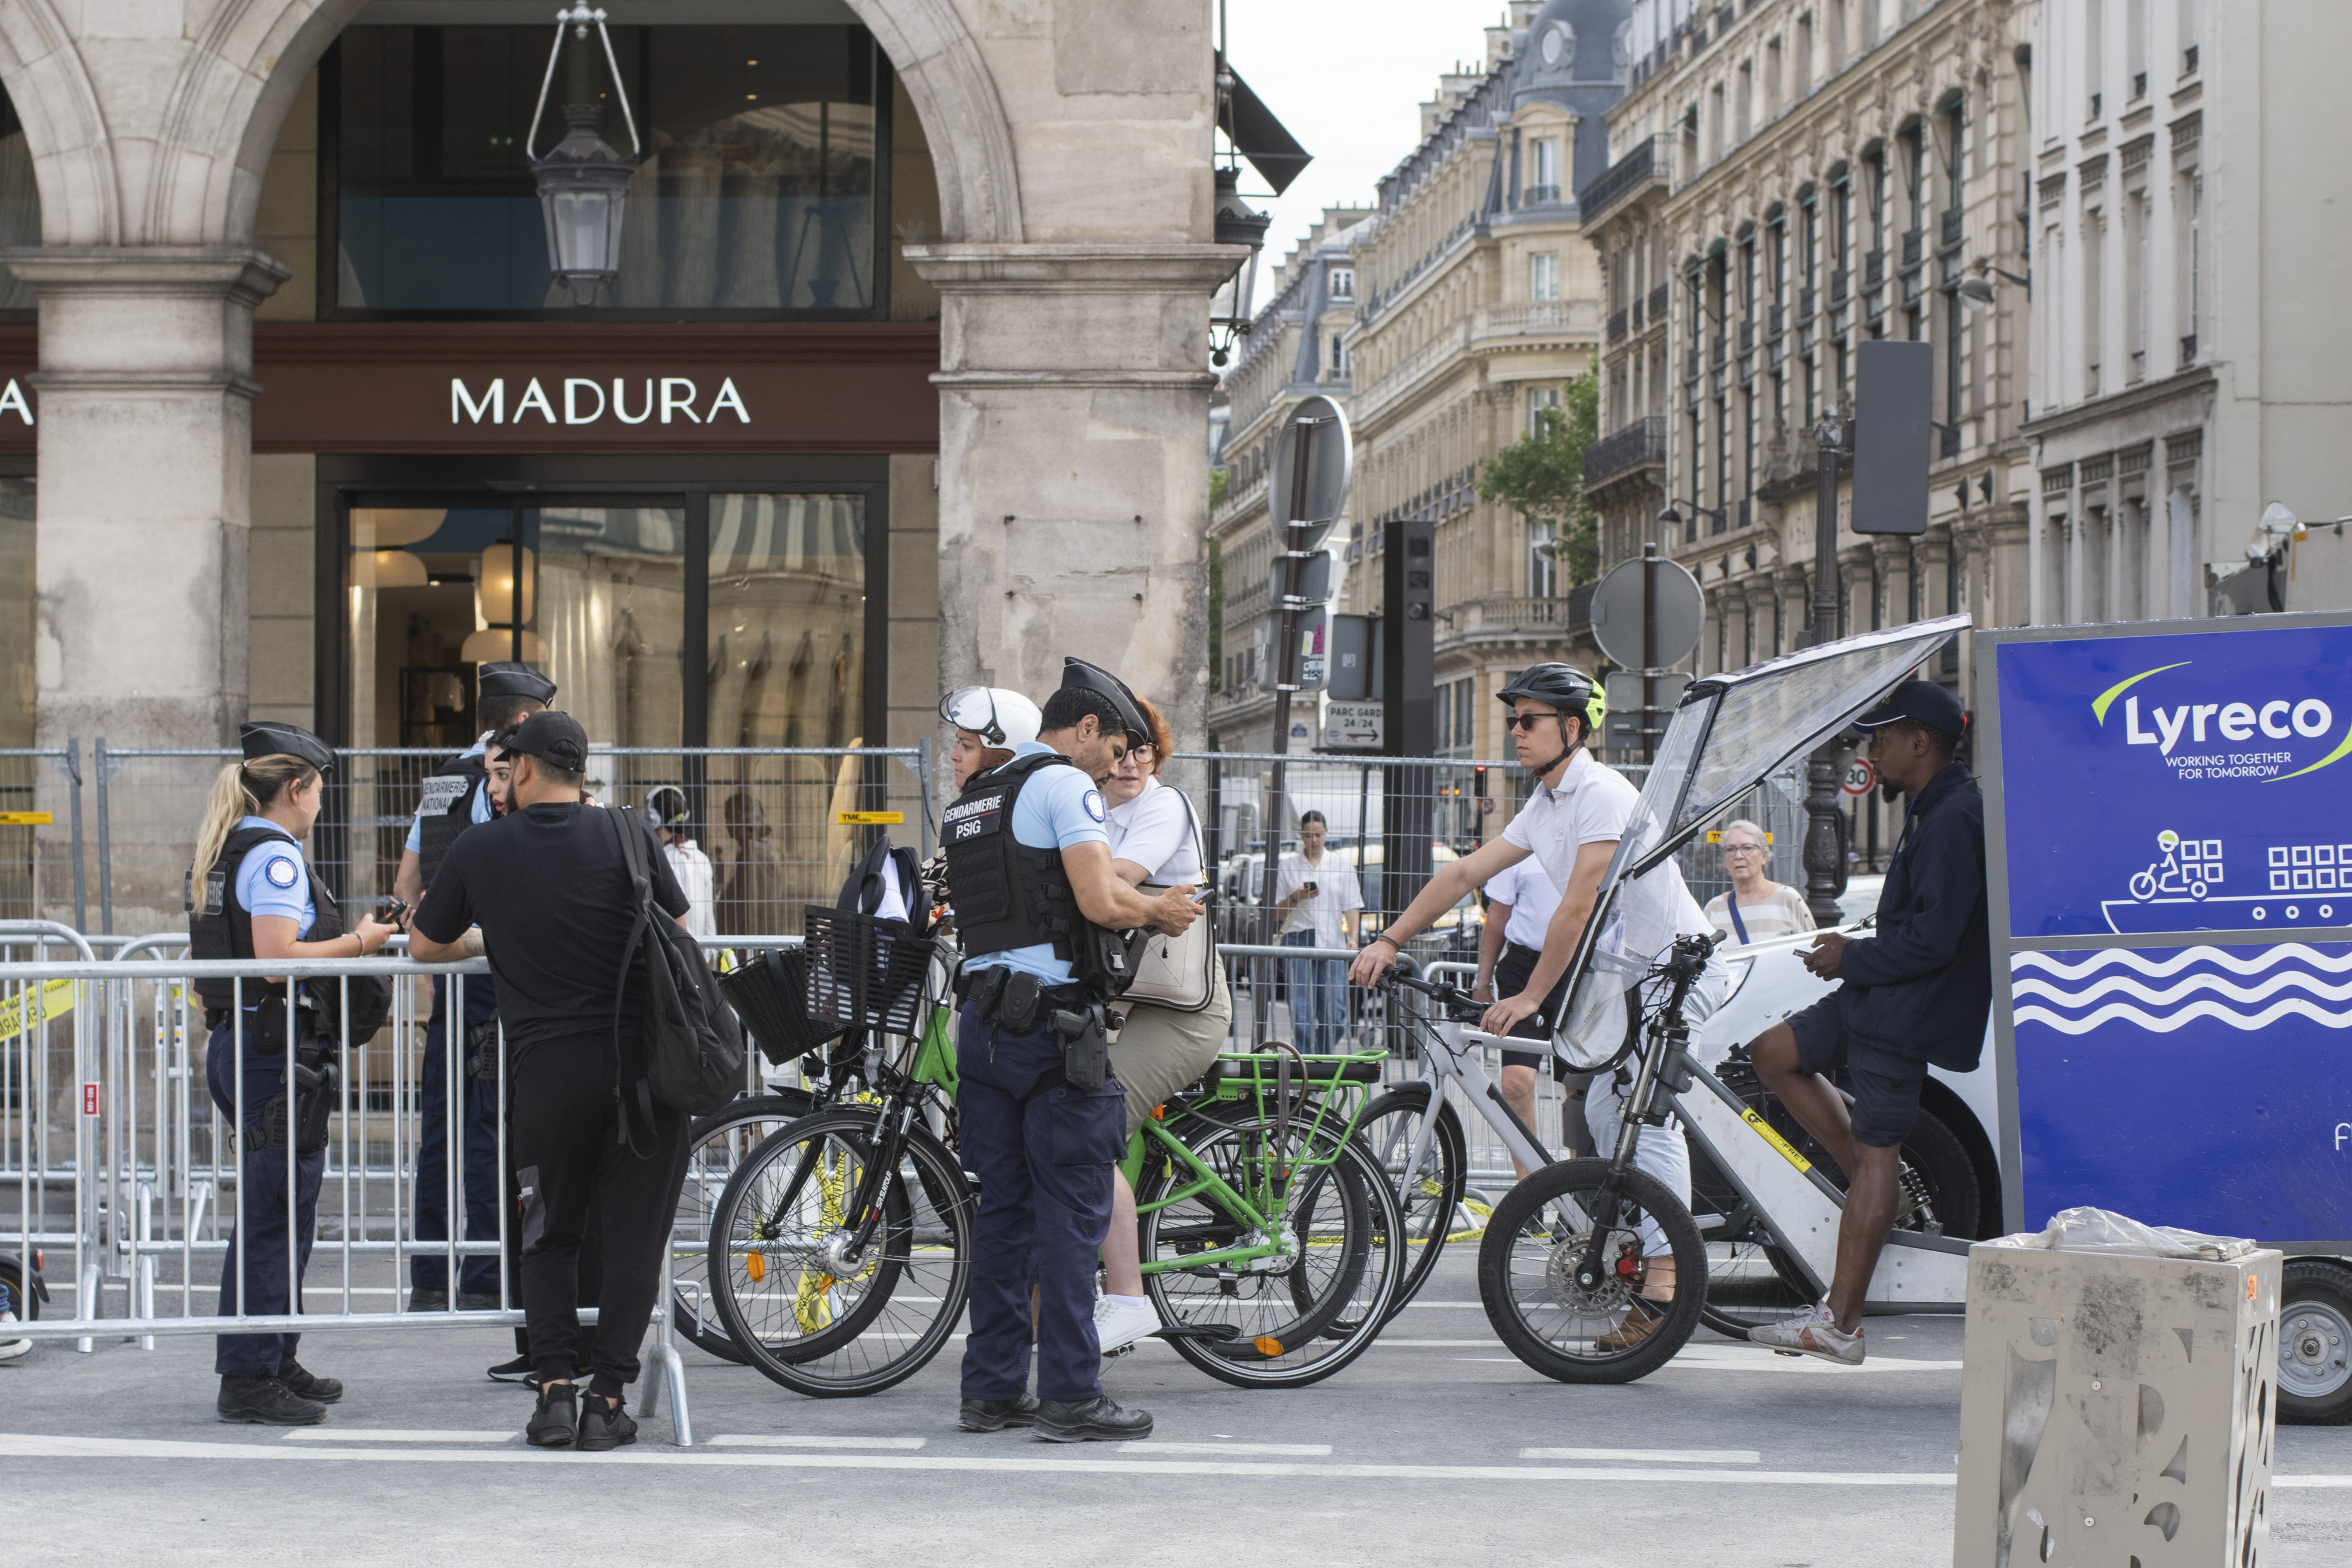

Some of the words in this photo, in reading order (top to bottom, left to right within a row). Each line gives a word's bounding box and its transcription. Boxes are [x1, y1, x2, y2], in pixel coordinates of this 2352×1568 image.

[451, 376, 751, 425] MADURA
[1331, 707, 1355, 717] PARC
[1357, 708, 1382, 717] GARD
[2125, 696, 2333, 757] Lyreco
[2165, 755, 2225, 767] WORKING
[2228, 752, 2291, 764] TOGETHER
[1845, 769, 1868, 785] 30
[2179, 769, 2203, 780] FOR
[2206, 765, 2278, 778] TOMORROW
[422, 797, 450, 811] NATIONAL
[944, 795, 1002, 823] GENDARMERIE
[956, 820, 981, 839] PSIG
[1760, 1123, 1808, 1164] CYCLOFRET
